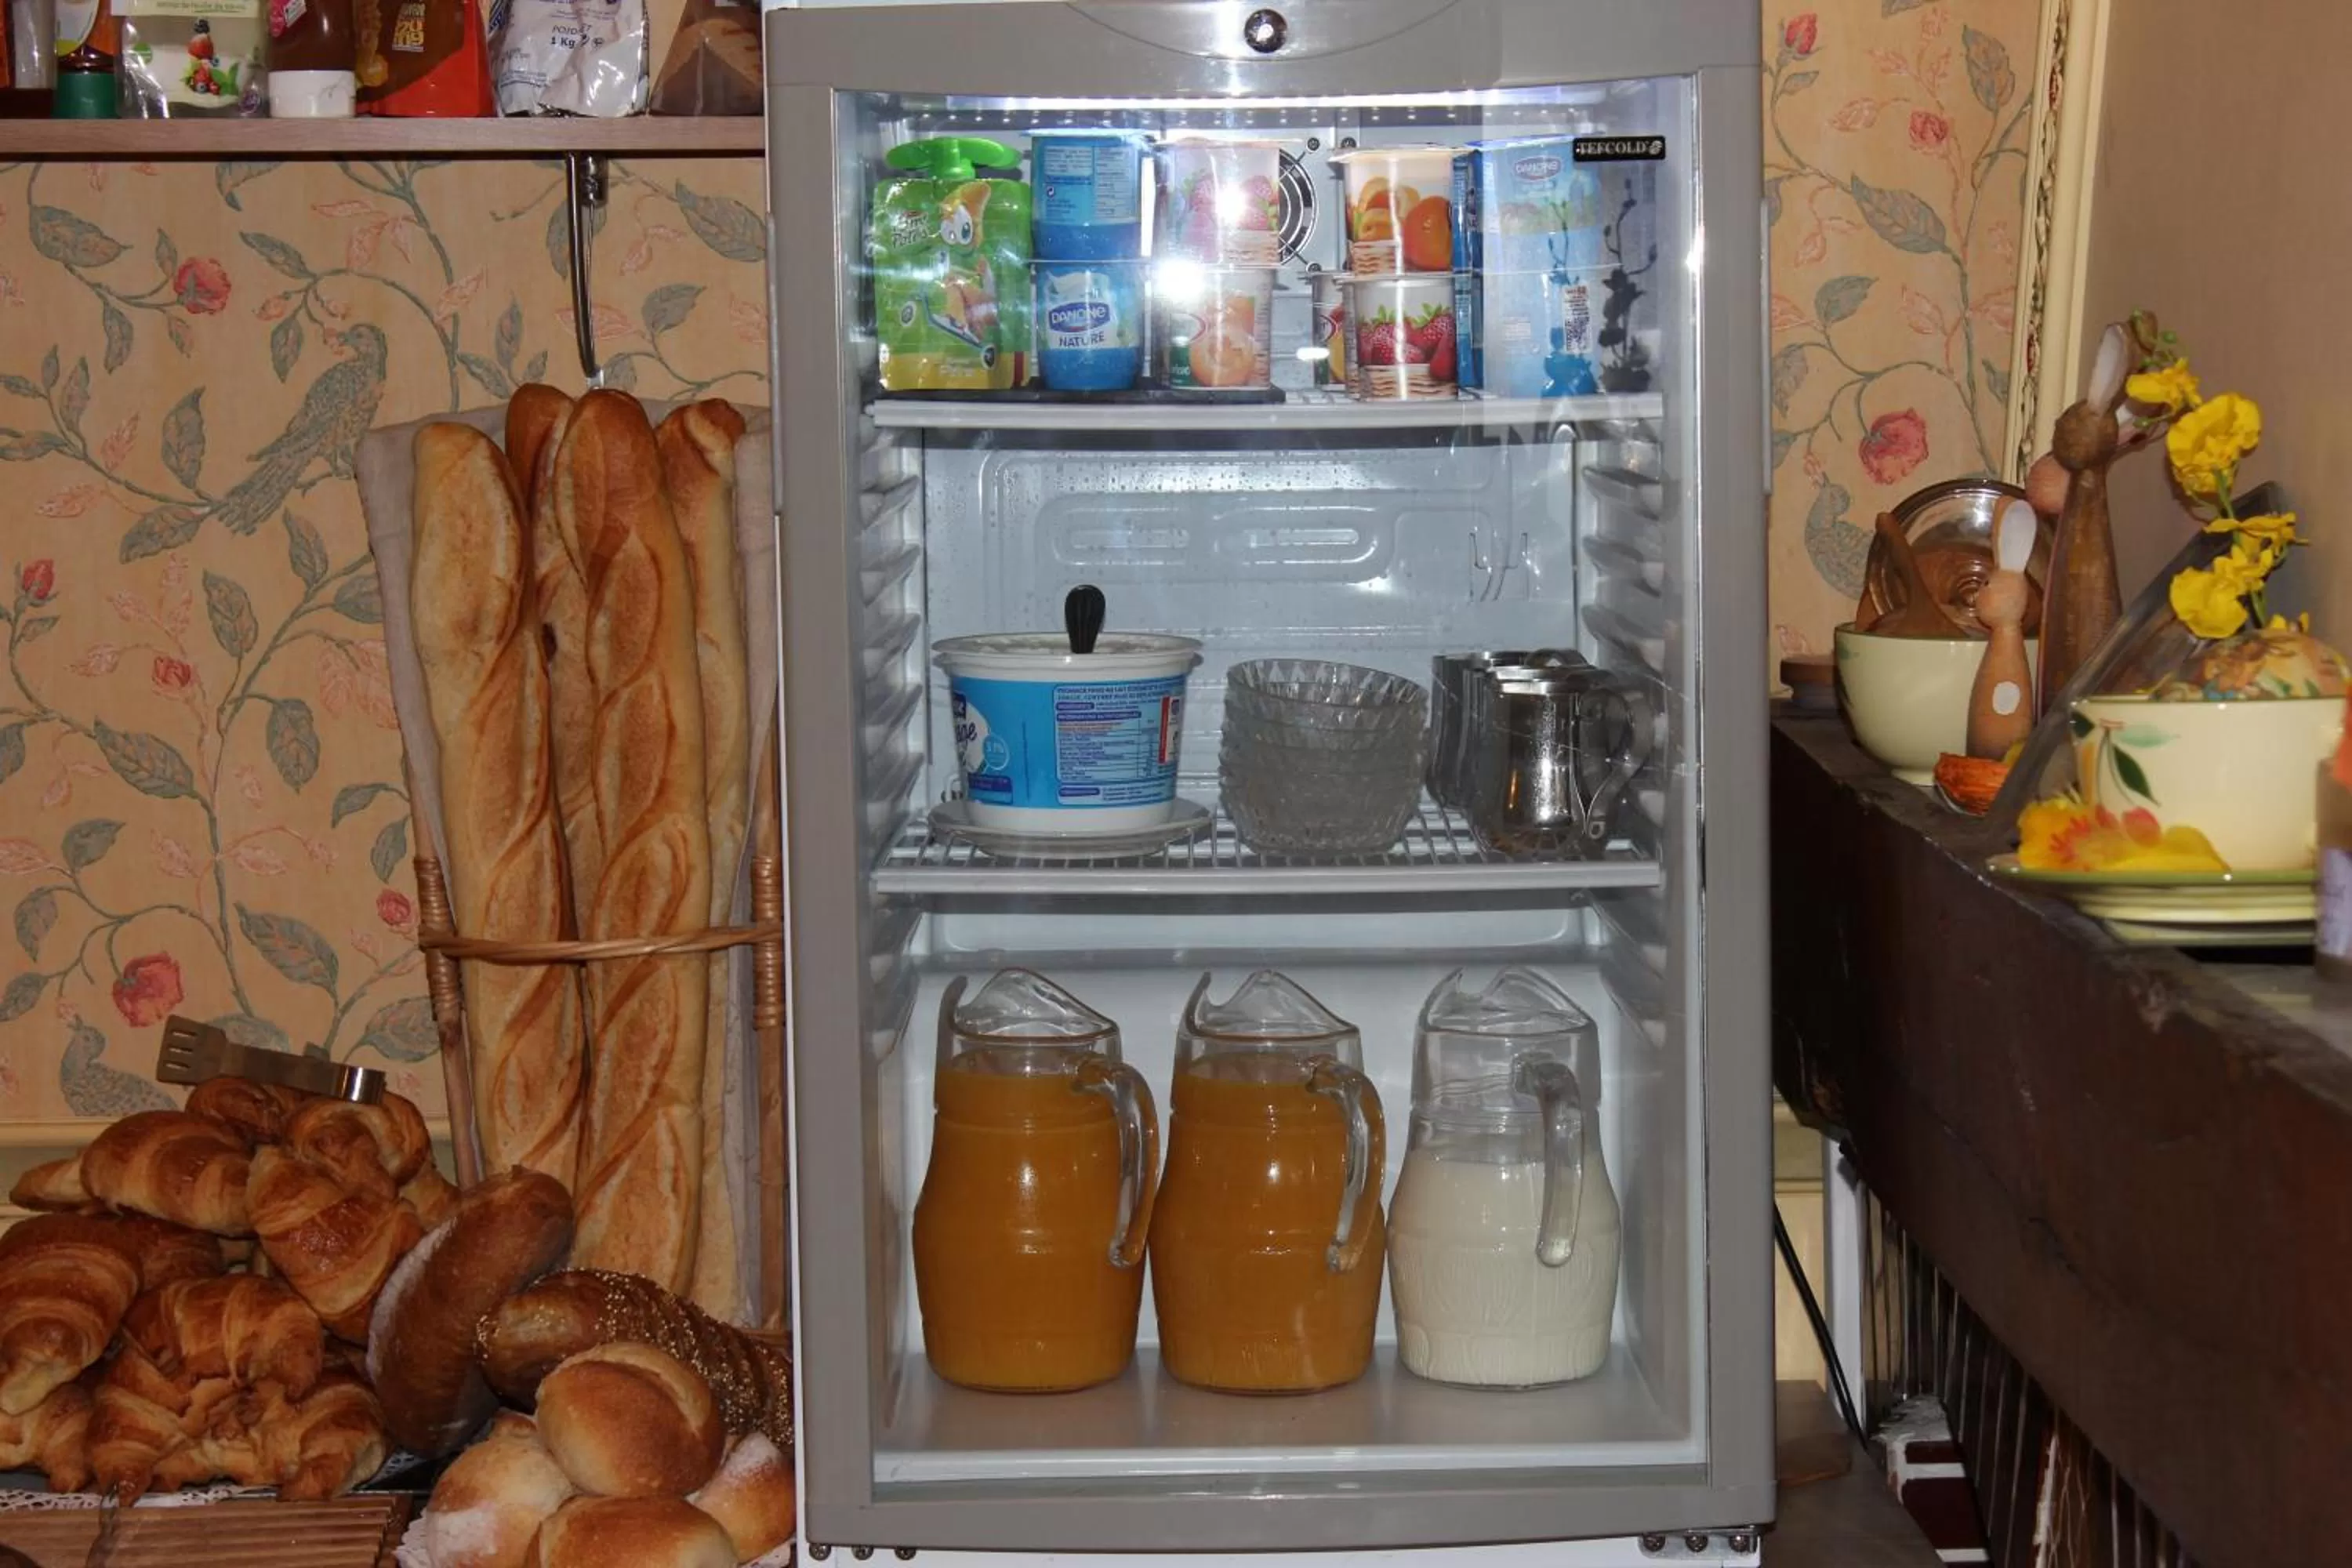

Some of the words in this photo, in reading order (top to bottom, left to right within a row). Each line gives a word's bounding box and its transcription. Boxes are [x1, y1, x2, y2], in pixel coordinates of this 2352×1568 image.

[561, 37, 576, 49] Kg
[1577, 141, 1646, 155] TEFCOLD
[1060, 331, 1105, 347] NATURE
